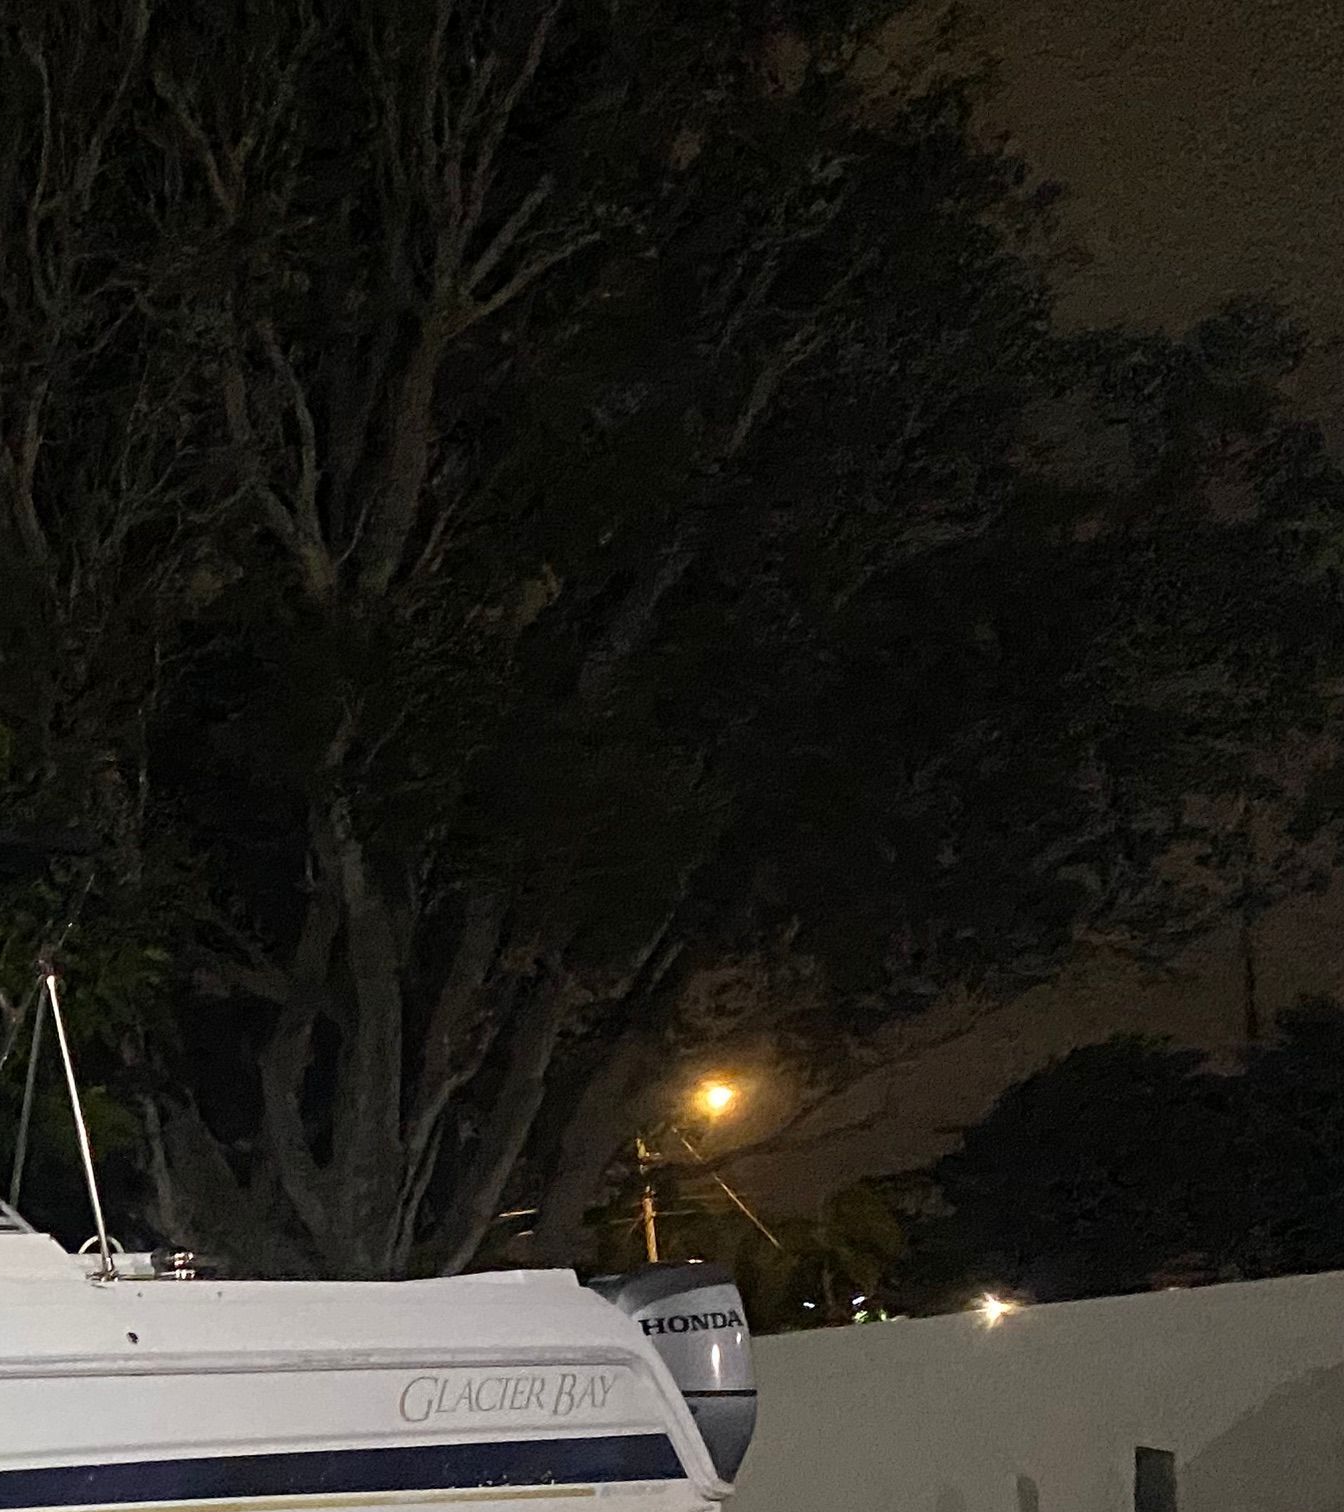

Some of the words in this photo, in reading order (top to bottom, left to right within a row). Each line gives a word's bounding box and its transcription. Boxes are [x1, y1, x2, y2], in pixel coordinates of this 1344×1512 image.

[638, 1309, 744, 1336] HONDA
[399, 1374, 546, 1422] GLACIER
[551, 1372, 614, 1416] BAY
